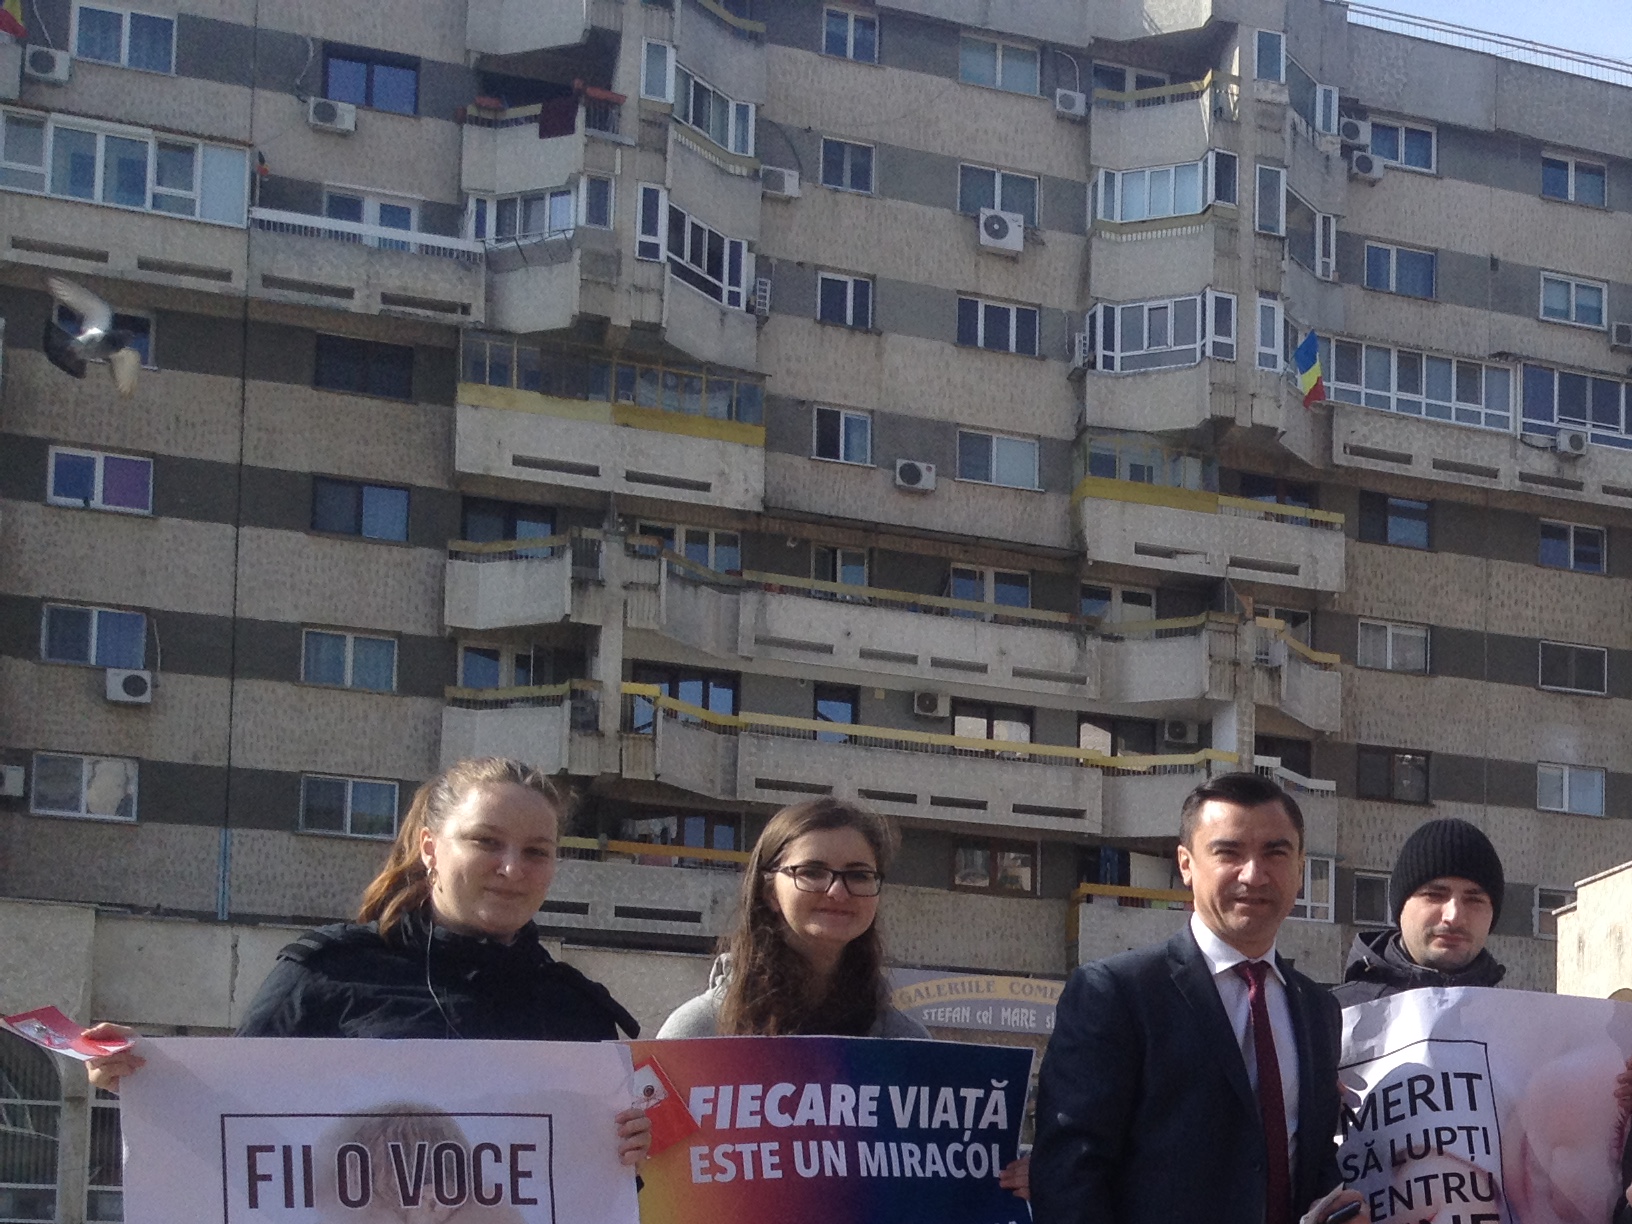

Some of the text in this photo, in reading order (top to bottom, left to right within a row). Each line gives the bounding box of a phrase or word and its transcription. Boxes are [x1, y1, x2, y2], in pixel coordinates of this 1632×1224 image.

[901, 980, 1060, 1004] GALERIILE COME
[922, 1006, 971, 1023] STEFAN
[976, 1006, 993, 1025] cel
[1001, 1007, 1037, 1028] MARE
[690, 1079, 1008, 1142] FIECARE VIAȚĂ
[1341, 1071, 1482, 1141] MERIT
[246, 1141, 538, 1209] FII O VOCE
[690, 1142, 784, 1184] ESTE
[792, 1140, 847, 1178] UN
[1342, 1125, 1491, 1184] SĂ LUPȚI
[1369, 1171, 1496, 1223] ENTRU
